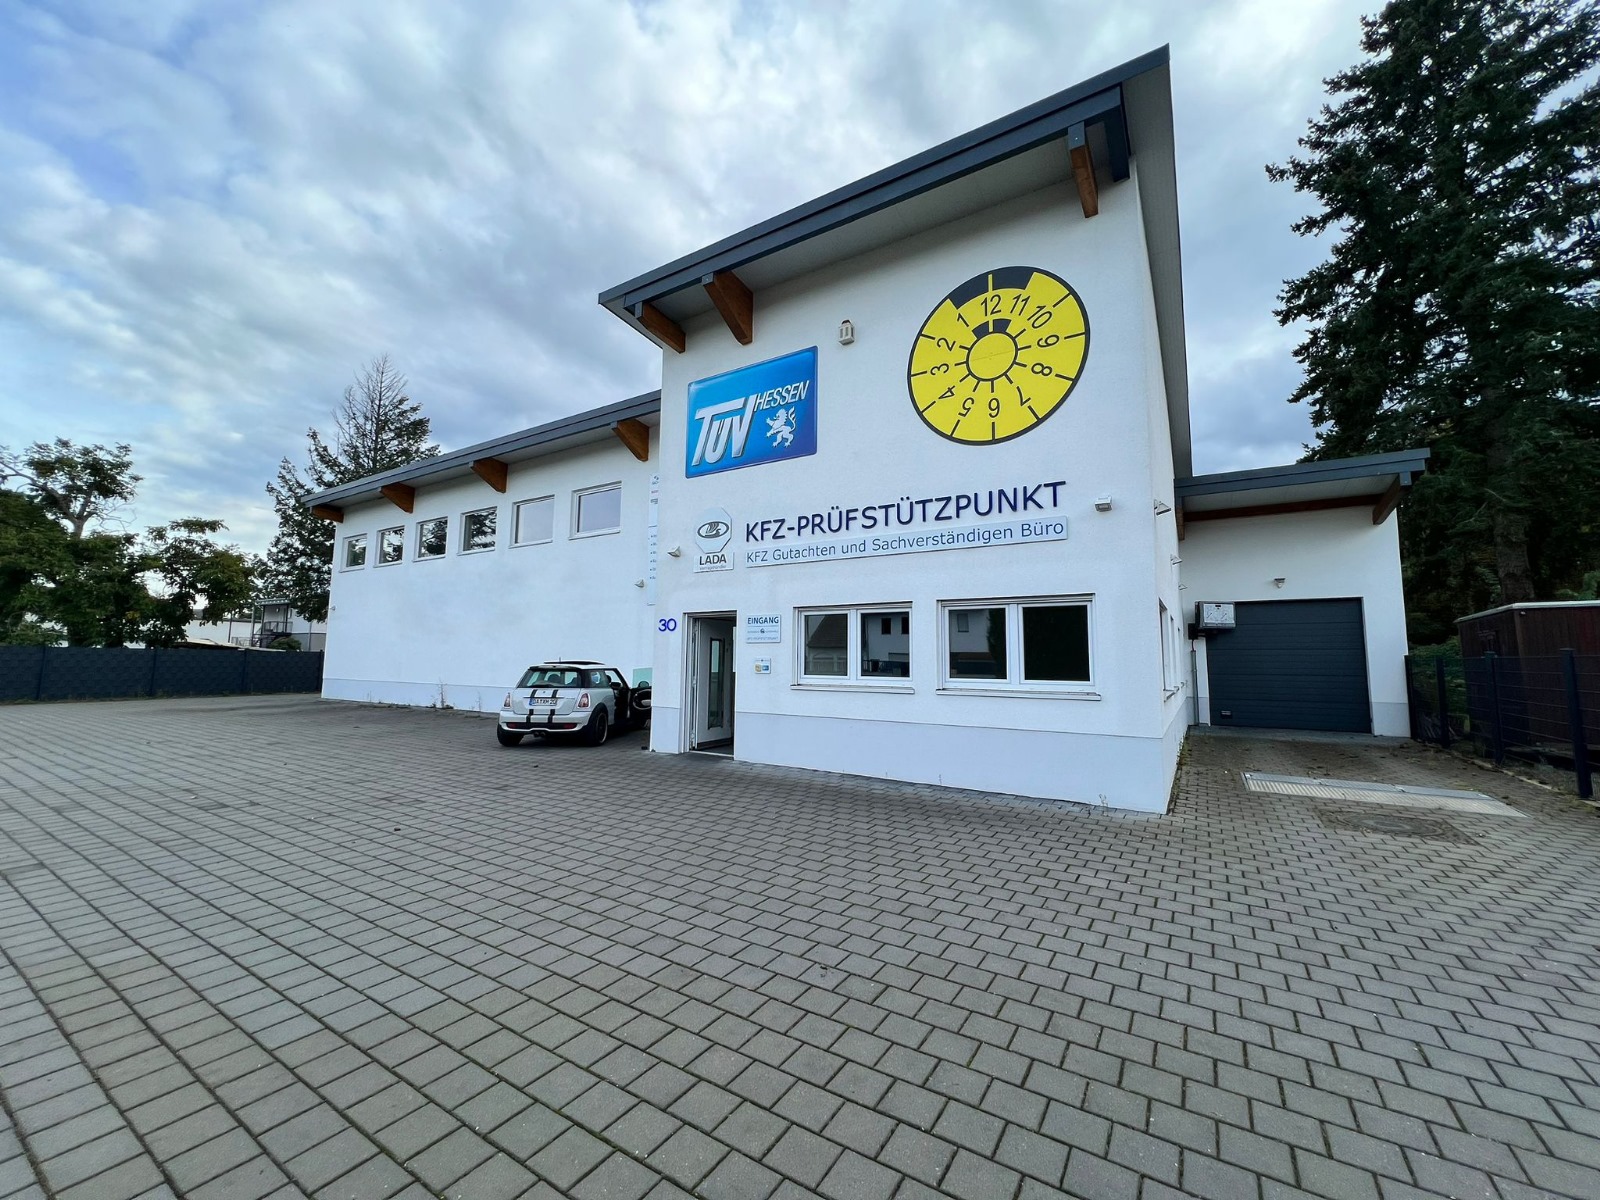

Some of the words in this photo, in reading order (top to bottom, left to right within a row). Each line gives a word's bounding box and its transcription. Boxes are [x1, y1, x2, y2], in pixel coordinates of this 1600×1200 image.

[980, 294, 1002, 317] 12
[1009, 293, 1031, 316] 11
[956, 312, 970, 328] 1
[1027, 305, 1053, 329] 10
[936, 337, 957, 352] 2
[1036, 334, 1060, 349] 9
[930, 363, 950, 376] 3
[1030, 362, 1053, 377] 8
[938, 385, 956, 400] 4
[1016, 385, 1032, 407] 7
[958, 397, 975, 418] 5
[988, 397, 1001, 418] 6
[691, 394, 757, 466] TÜV
[754, 380, 810, 411] HESSEN
[745, 480, 1067, 543] KFZ-PRÜFSTÜTZPUNKT
[746, 550, 768, 563] KFZ
[772, 545, 836, 561] Gutachten
[841, 539, 866, 554] und
[872, 528, 1013, 551] Sachverständigen
[1021, 521, 1064, 538] Büro
[699, 553, 727, 566] LADA
[658, 618, 677, 632] 30
[747, 616, 779, 625] EINGANG
